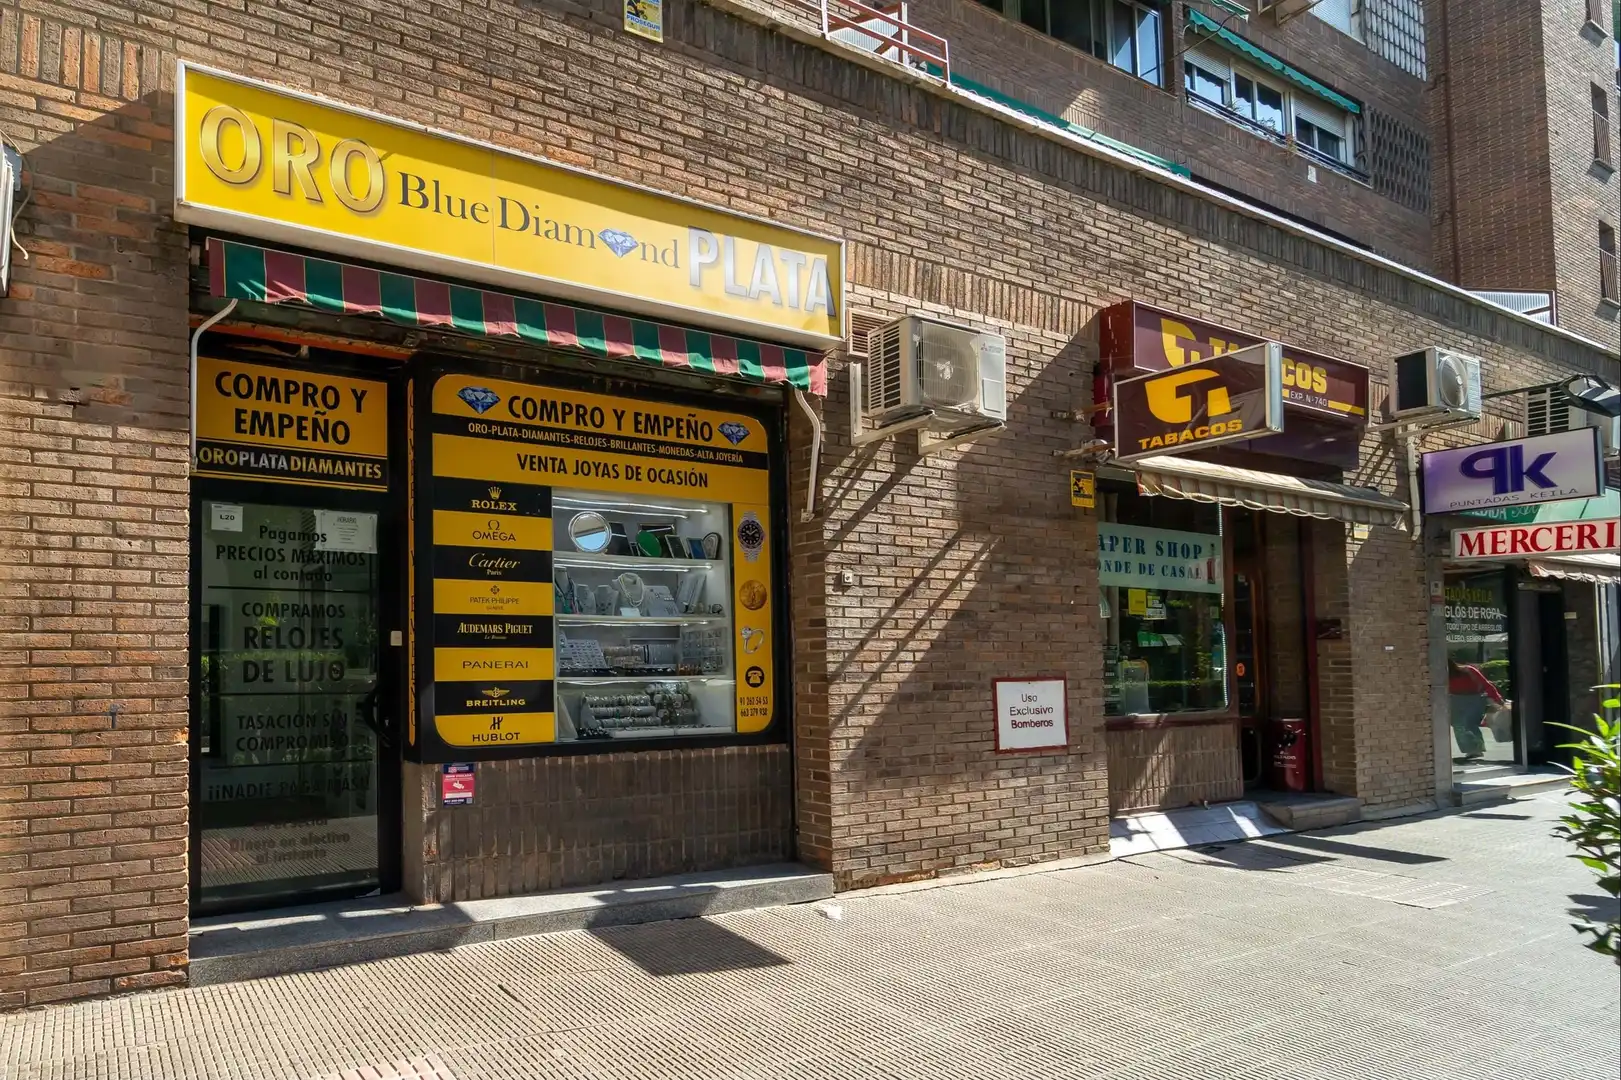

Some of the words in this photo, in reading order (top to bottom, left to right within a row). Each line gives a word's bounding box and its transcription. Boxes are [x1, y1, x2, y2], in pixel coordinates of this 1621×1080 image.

[200, 105, 386, 213] ORO
[688, 225, 836, 317] PLATA
[215, 371, 340, 410] COMPRO
[351, 388, 368, 413] Y
[235, 408, 350, 445] EMPEÑO
[508, 395, 605, 429] COMPRO
[613, 408, 626, 430] Y
[634, 411, 713, 442] EMPEÑO
[1138, 418, 1243, 450] TABACOS
[517, 453, 567, 474] VENTA
[573, 459, 620, 479] JOYAS
[625, 464, 642, 481] DE
[647, 466, 708, 488] OCASIÓN
[471, 499, 518, 511] ROLEX
[1450, 494, 1519, 508] PUNTADAS
[1530, 487, 1579, 499] KEILA
[259, 525, 327, 544] Pagamos
[472, 530, 516, 542] OMEGA
[216, 545, 285, 562] PRECIOS
[1156, 540, 1202, 560] SHOP
[468, 552, 521, 569] Cartier
[1138, 562, 1155, 576] DE
[253, 565, 267, 580] al
[273, 568, 333, 582] contado
[469, 596, 490, 604] PATEK
[491, 597, 520, 605] PHILIPPE
[241, 602, 346, 618] COMPRAMOS
[1444, 605, 1467, 618] GLOS
[1468, 606, 1480, 619] DE
[1480, 607, 1502, 620] ROPA
[457, 622, 503, 634] AUDEMARS
[504, 622, 533, 634] PIGUET
[244, 627, 344, 650] RELOJES
[243, 659, 274, 683] DE
[285, 660, 345, 683] LUJO
[462, 661, 529, 669] PANERAI
[466, 699, 526, 707] BREITLING
[1021, 693, 1038, 703] Uso
[1009, 705, 1054, 716] Exclusivo
[1011, 719, 1054, 729] Bomberos
[236, 733, 349, 751] COMPROMISO
[472, 732, 520, 742] HUBLOT
